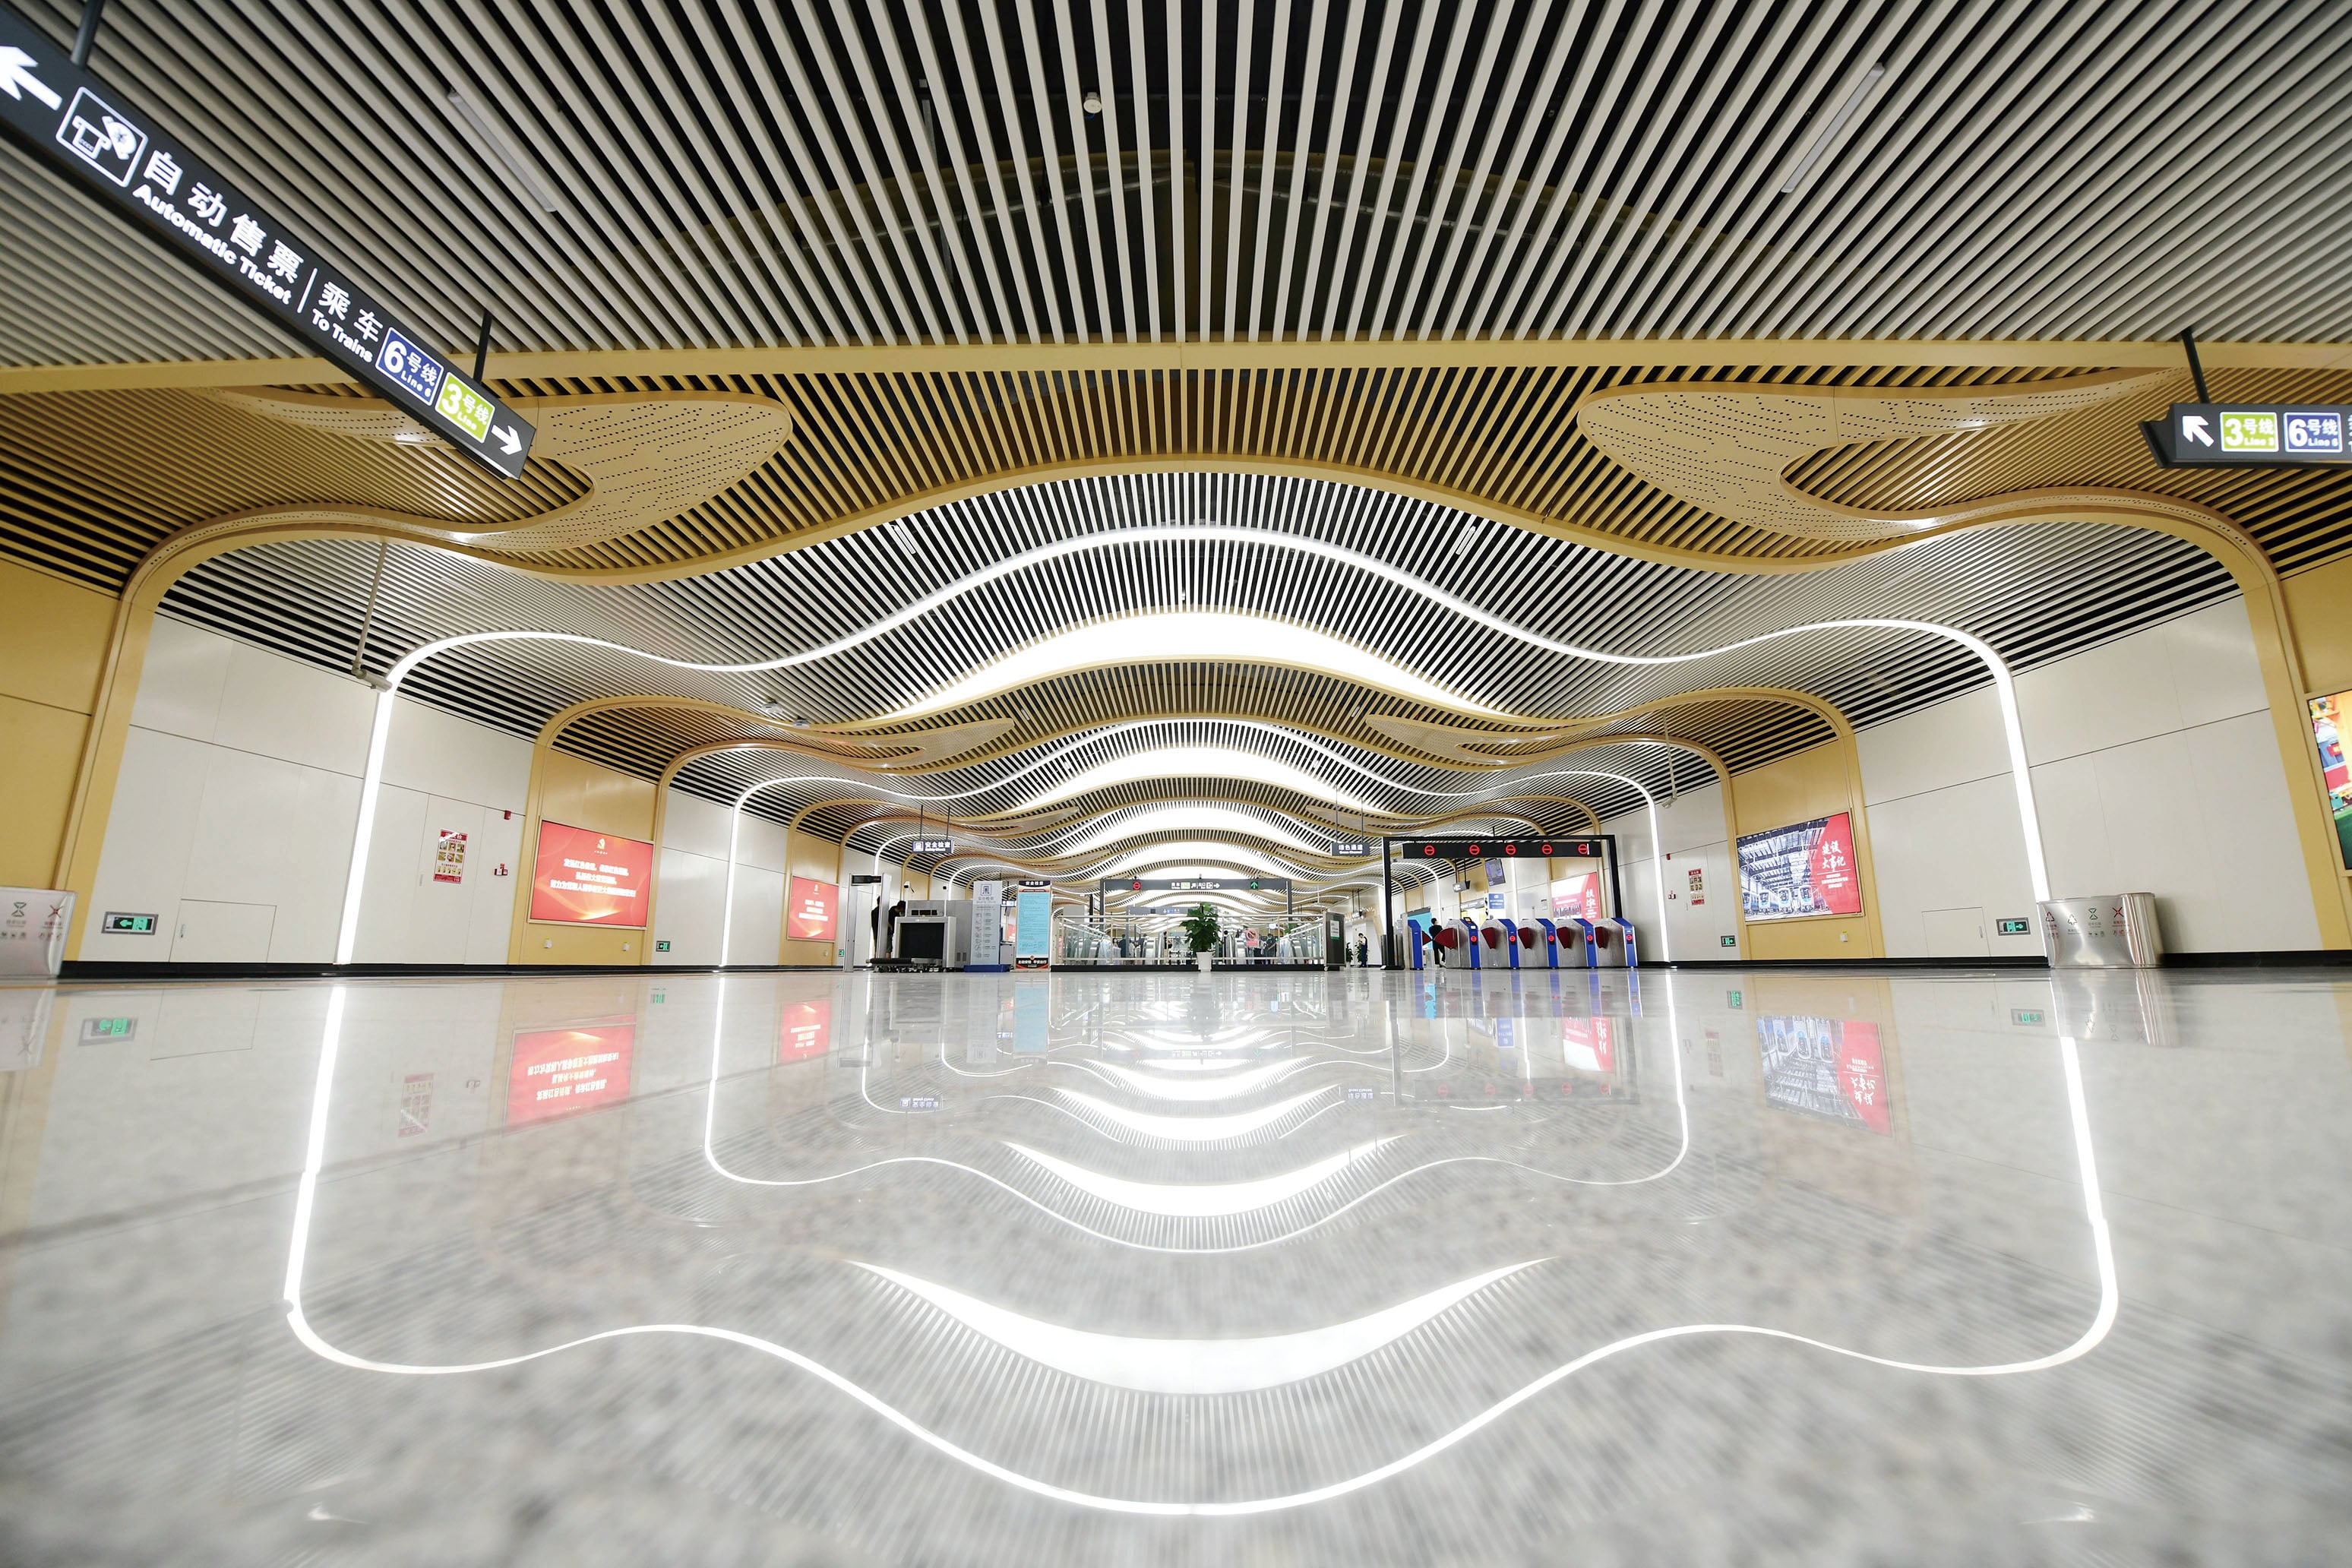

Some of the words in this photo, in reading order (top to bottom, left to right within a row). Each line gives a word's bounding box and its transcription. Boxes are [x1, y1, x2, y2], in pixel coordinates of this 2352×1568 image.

[144, 150, 304, 284] 自动售票
[132, 184, 237, 264] Automatic
[239, 256, 292, 304] Ticket
[318, 281, 383, 342] 乘车
[311, 308, 330, 331] To
[332, 323, 373, 362] Trains
[384, 340, 438, 387] 6号线
[400, 370, 423, 392] Line
[441, 383, 489, 425] 3号线
[457, 411, 477, 431] Line
[2224, 418, 2275, 447] 3号线
[2244, 437, 2266, 446] Line
[2288, 419, 2338, 447] 6号线
[2308, 438, 2330, 447] Line
